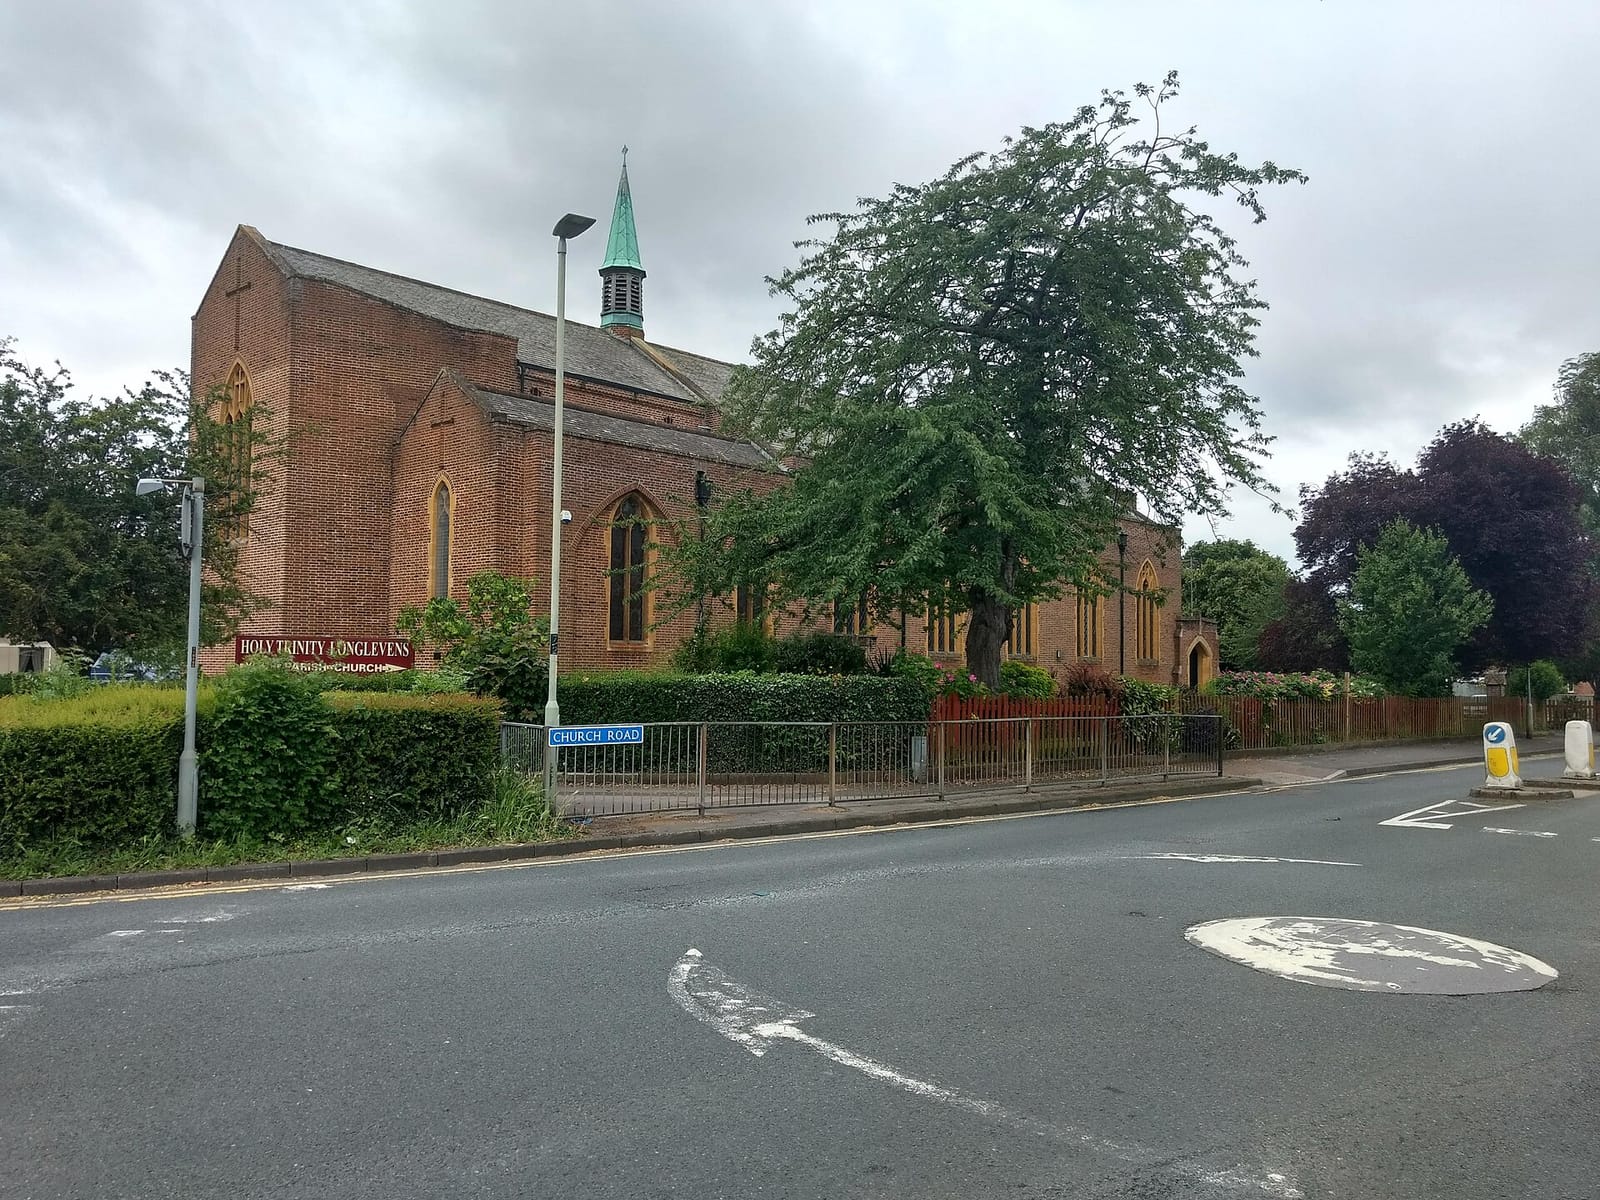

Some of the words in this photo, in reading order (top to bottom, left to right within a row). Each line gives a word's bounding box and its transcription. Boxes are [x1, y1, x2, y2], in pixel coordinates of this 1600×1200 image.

[241, 639, 274, 654] HOLY
[276, 640, 326, 655] TRINITY
[334, 663, 382, 673] CHURCH
[553, 731, 601, 743] CHURCH
[607, 729, 640, 741] ROAD
